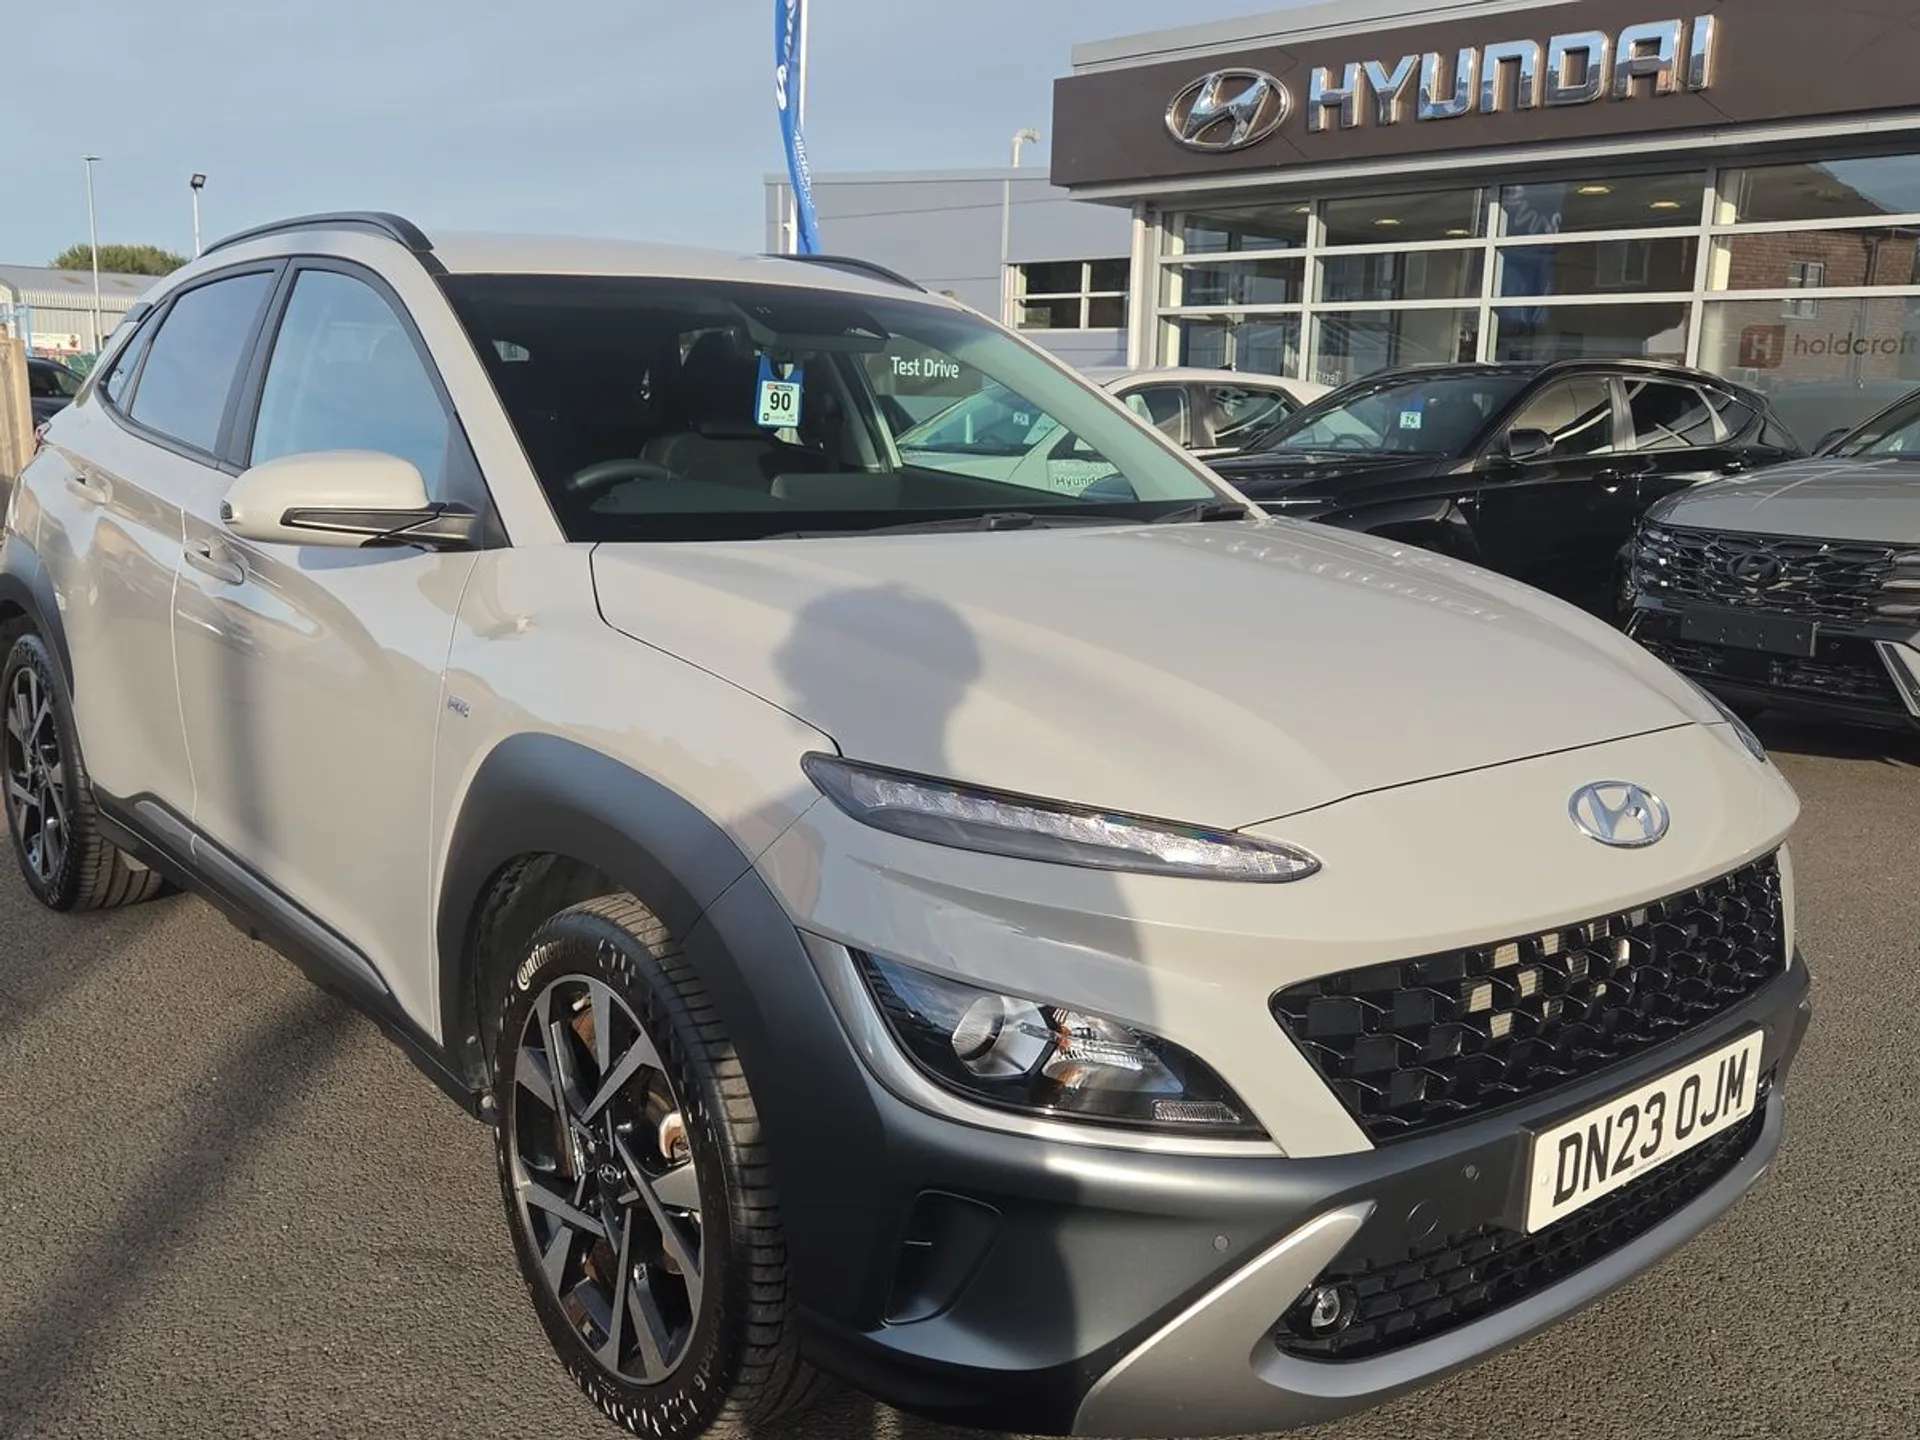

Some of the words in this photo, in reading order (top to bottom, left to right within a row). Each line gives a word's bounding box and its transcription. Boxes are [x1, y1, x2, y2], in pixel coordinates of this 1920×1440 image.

[1308, 14, 1715, 132] HYUNDAI
[770, 391, 791, 411] 90
[891, 356, 920, 376] Test
[924, 358, 959, 379] Drive
[1552, 1091, 1666, 1207] DN23
[1675, 1048, 1750, 1141] OJM
